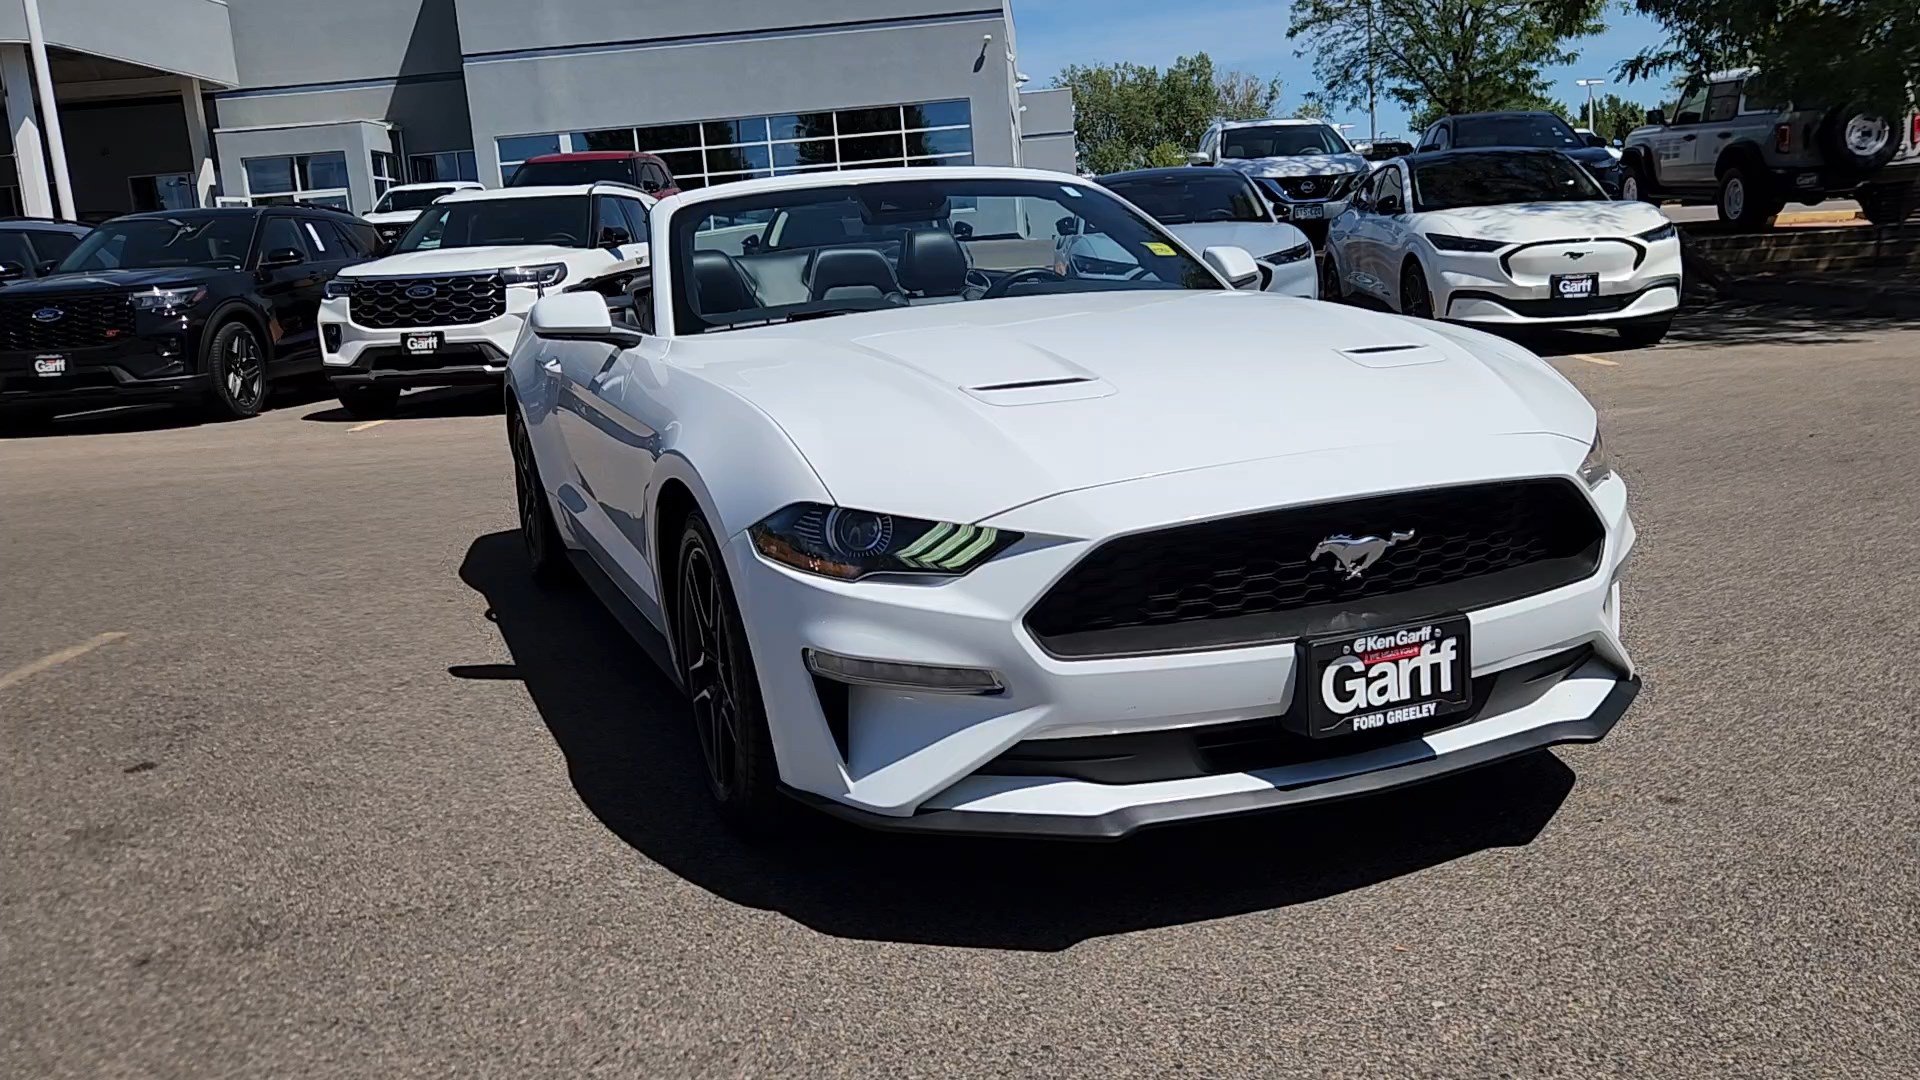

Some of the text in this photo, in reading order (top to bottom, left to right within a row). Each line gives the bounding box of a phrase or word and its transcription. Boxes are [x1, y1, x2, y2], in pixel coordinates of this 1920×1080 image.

[1559, 279, 1592, 293] Garff
[407, 336, 438, 350] Garff
[35, 359, 66, 373] Garff
[1367, 635, 1395, 652] Ken
[1396, 626, 1432, 645] Garff
[1321, 637, 1457, 714] Garff
[1353, 703, 1437, 731] FORD GREELEY
